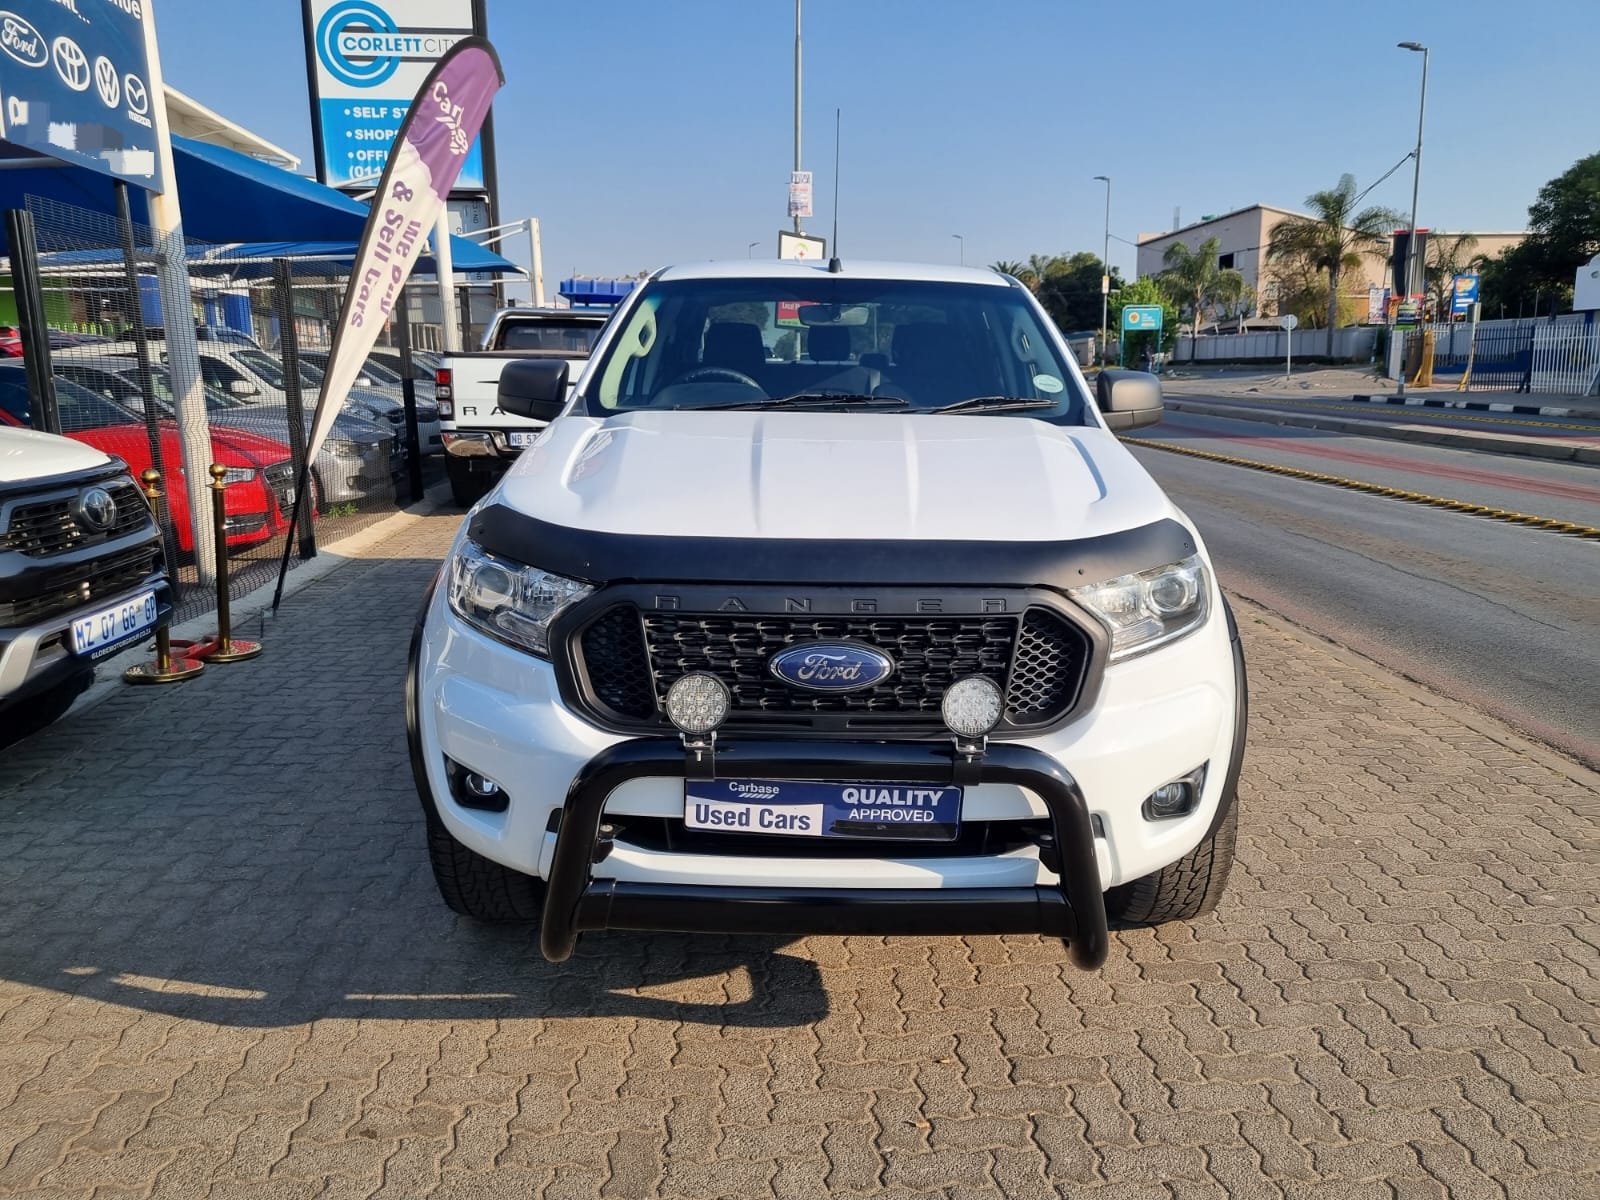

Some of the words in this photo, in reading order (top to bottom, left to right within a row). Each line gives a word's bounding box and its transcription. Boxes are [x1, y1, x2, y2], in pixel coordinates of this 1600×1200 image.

[2, 18, 37, 58] Ford
[343, 36, 422, 53] CORLETT
[353, 107, 387, 118] SELF
[392, 107, 409, 119] ST
[356, 150, 389, 161] OFFI
[392, 181, 413, 202] &
[374, 209, 404, 263] Sell
[351, 268, 382, 328] Cars
[463, 407, 506, 416] RA
[655, 595, 1007, 612] RANGER
[101, 613, 115, 640] 07
[122, 606, 136, 631] GG
[145, 596, 155, 621] GP
[798, 654, 862, 680] Ford
[729, 781, 780, 795] Carbase
[842, 788, 944, 806] QUALITY
[695, 804, 749, 827] Used
[759, 809, 811, 830] Cars
[849, 809, 934, 822] APPROVED
